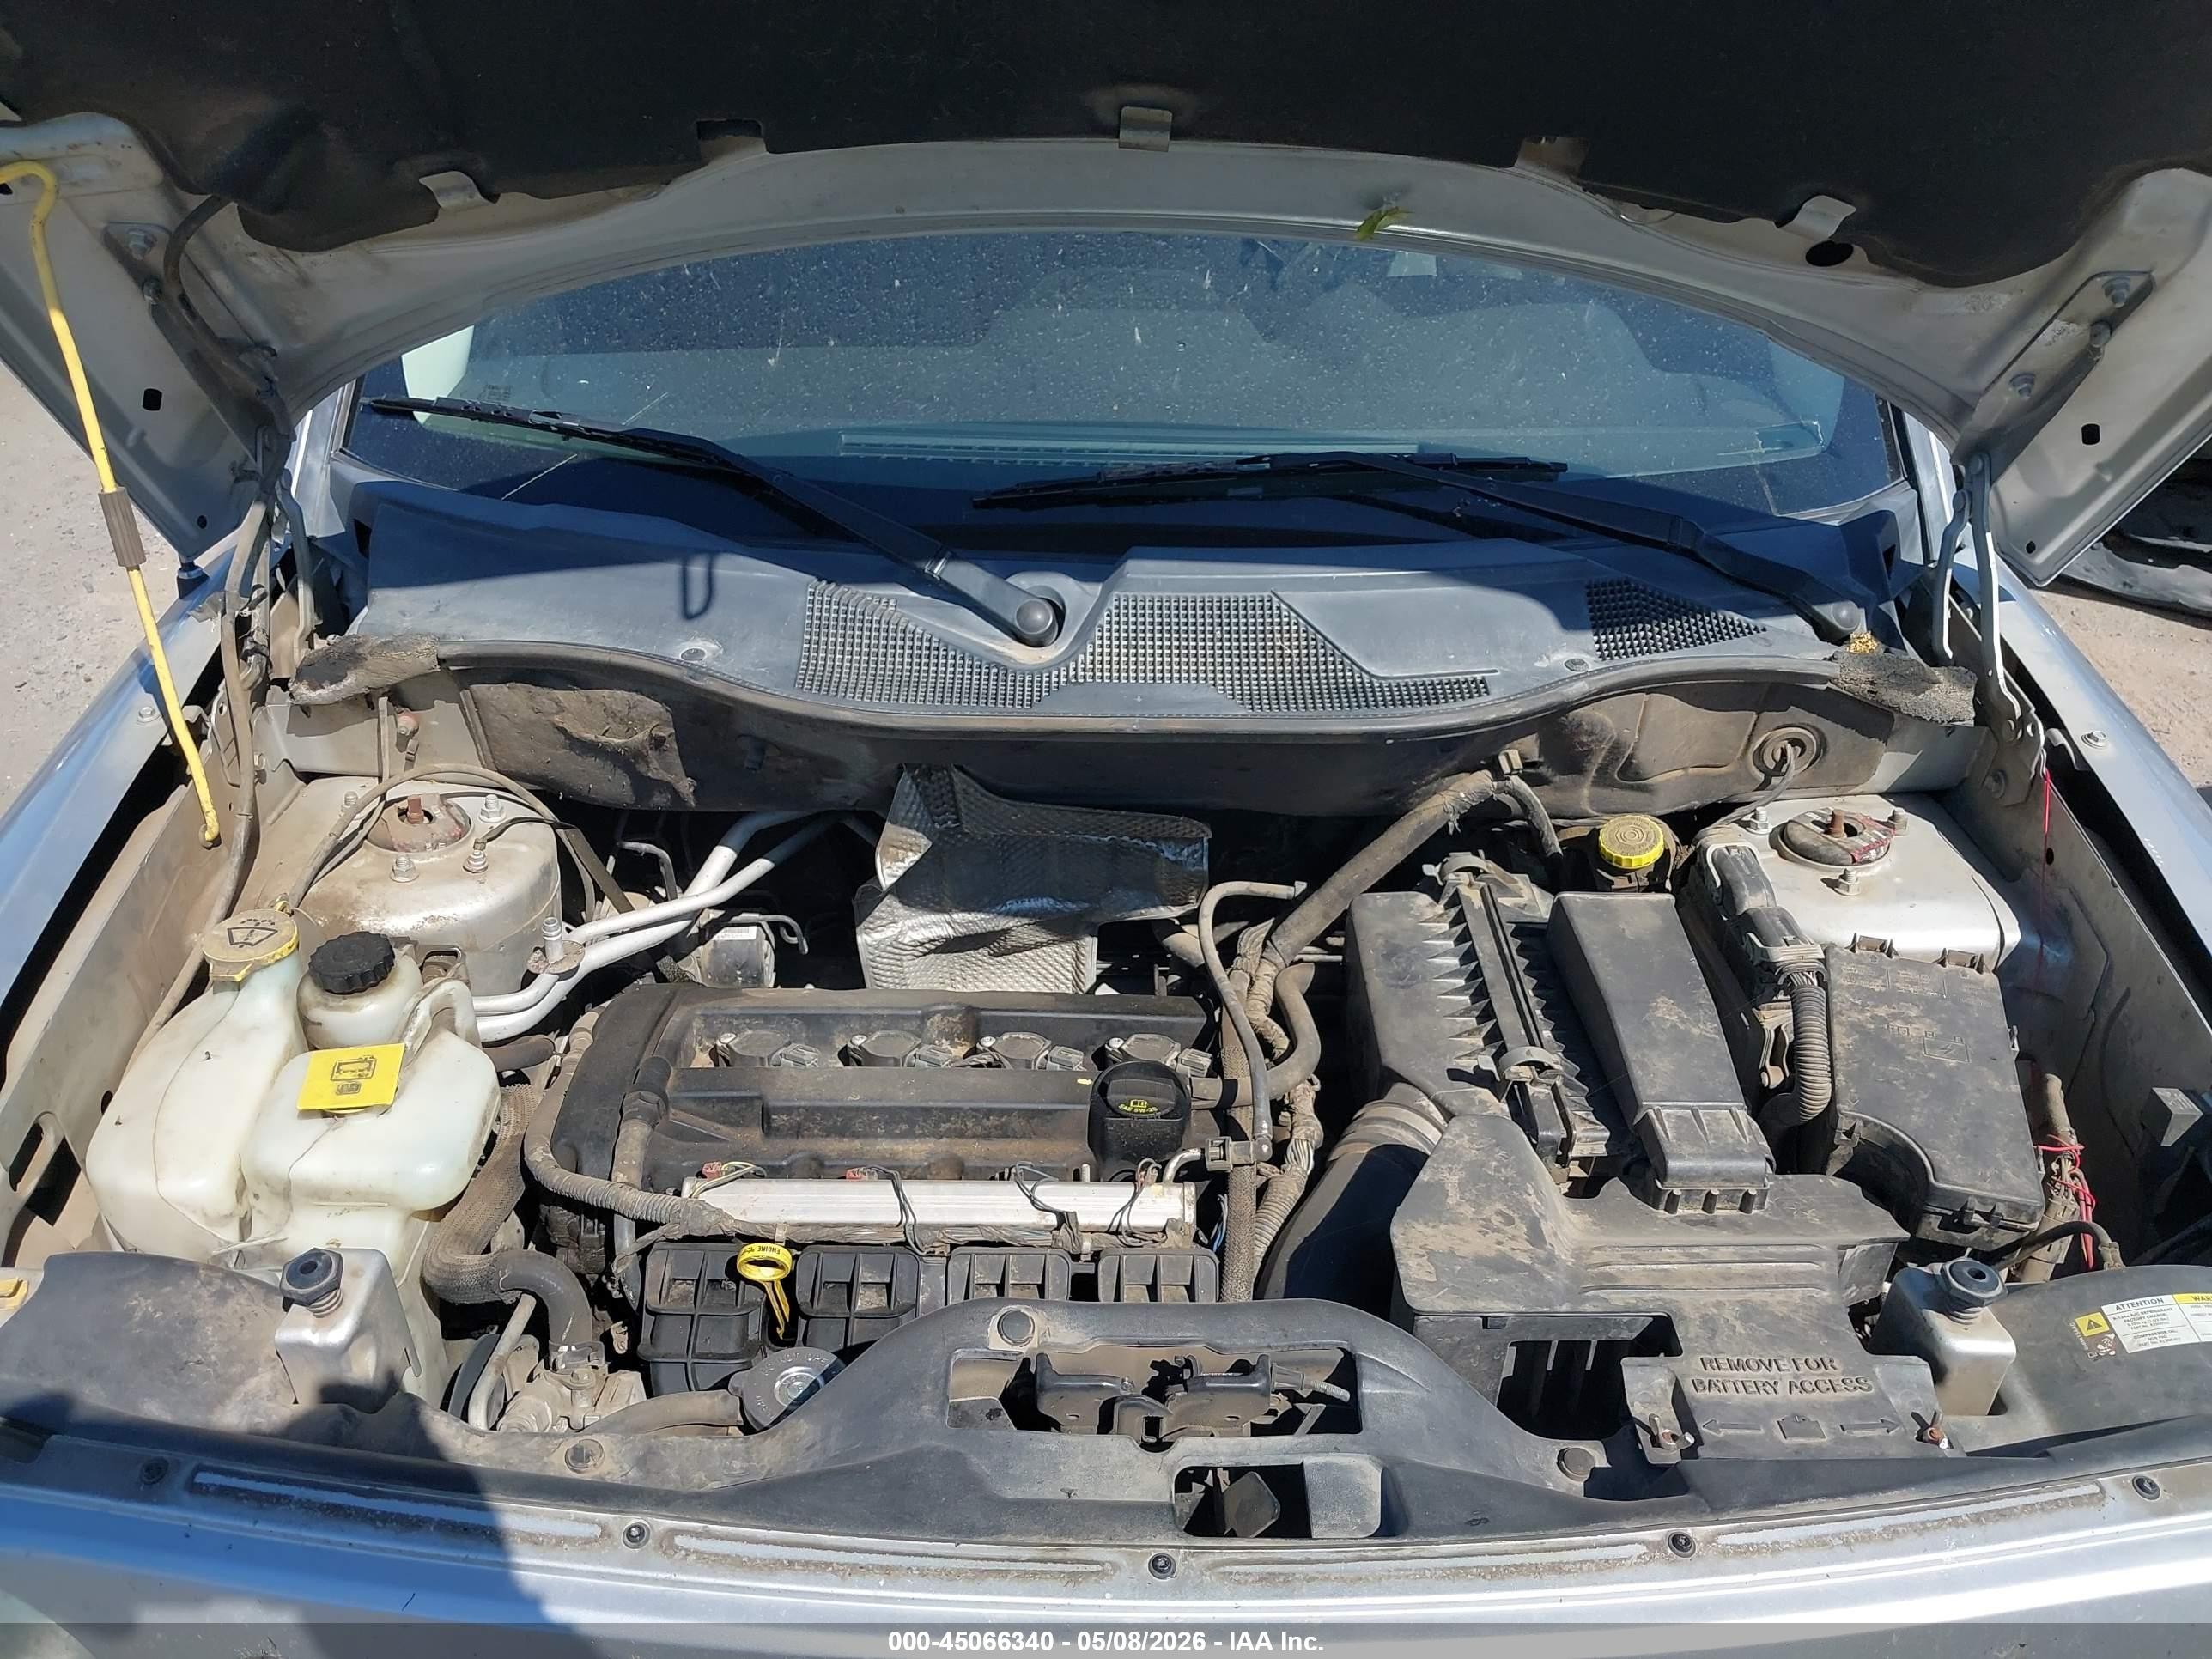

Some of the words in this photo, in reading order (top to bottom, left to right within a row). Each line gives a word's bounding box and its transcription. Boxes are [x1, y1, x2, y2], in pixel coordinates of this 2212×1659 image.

[757, 1245, 781, 1255] ENGINE
[2116, 1297, 2164, 1310] ATTENTION
[1700, 1357, 1790, 1372] REMOVE
[1791, 1357, 1838, 1372] FOR
[1691, 1378, 1779, 1395] BATTERY
[1788, 1376, 1874, 1395] ACCESS
